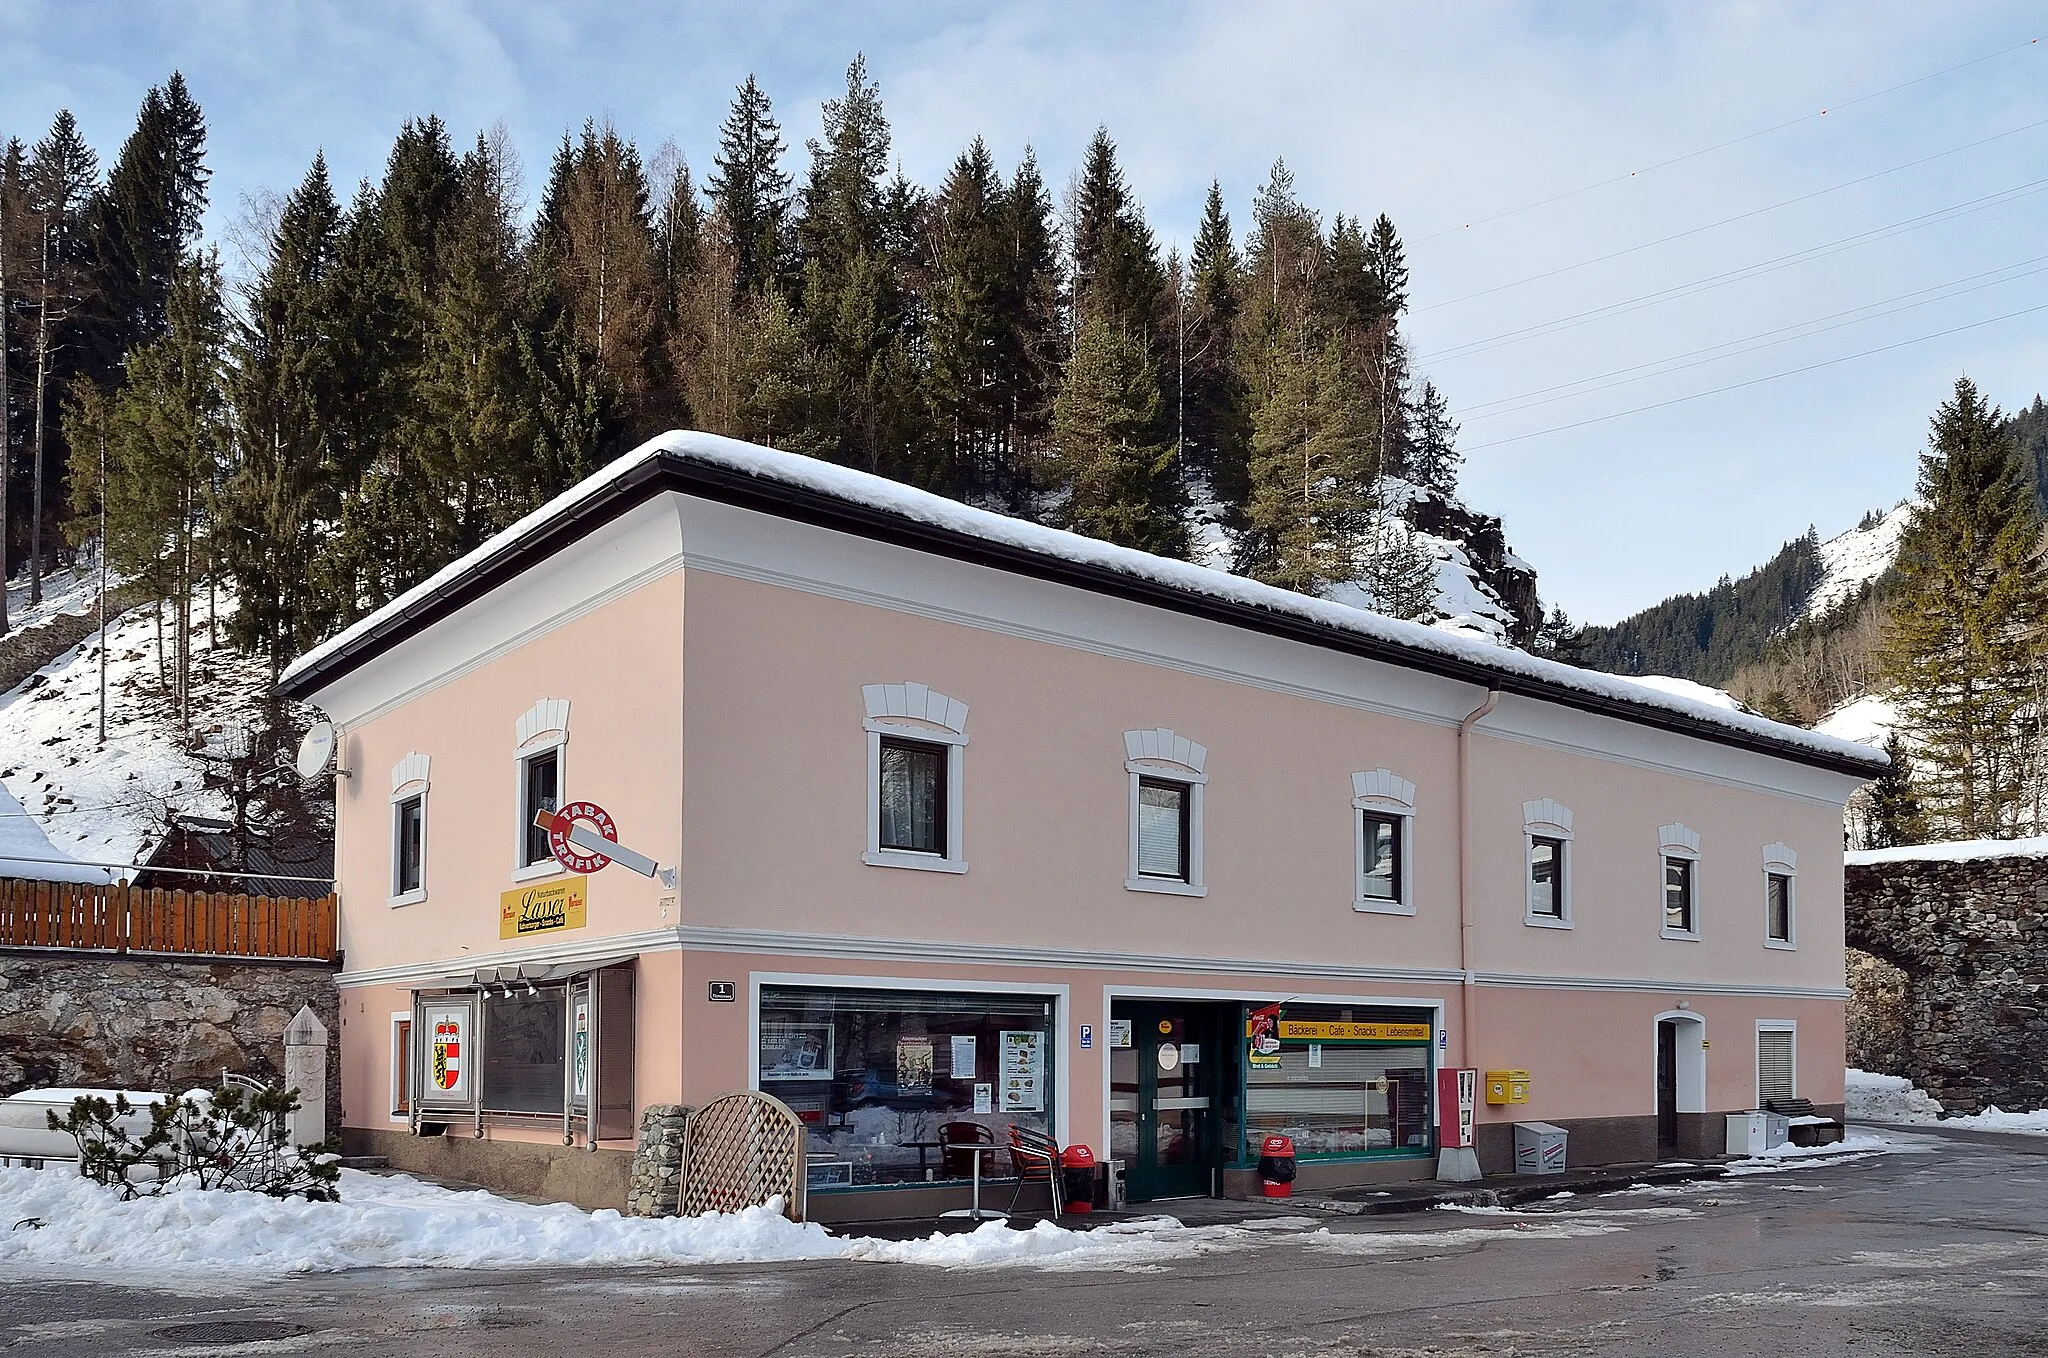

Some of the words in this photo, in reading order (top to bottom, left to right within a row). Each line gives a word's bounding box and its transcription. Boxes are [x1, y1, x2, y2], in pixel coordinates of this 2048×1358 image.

[560, 805, 614, 836] TABAK
[553, 832, 606, 870] TRAFIK
[518, 888, 565, 921] Lasser
[718, 984, 726, 994] 1
[1082, 1026, 1091, 1038] P
[1288, 1024, 1318, 1036] Bäckerei
[1328, 1024, 1345, 1036] Cafe
[1353, 1025, 1377, 1037] Snacks
[1386, 1026, 1424, 1037] Lebensmittel
[1440, 1031, 1446, 1041] P
